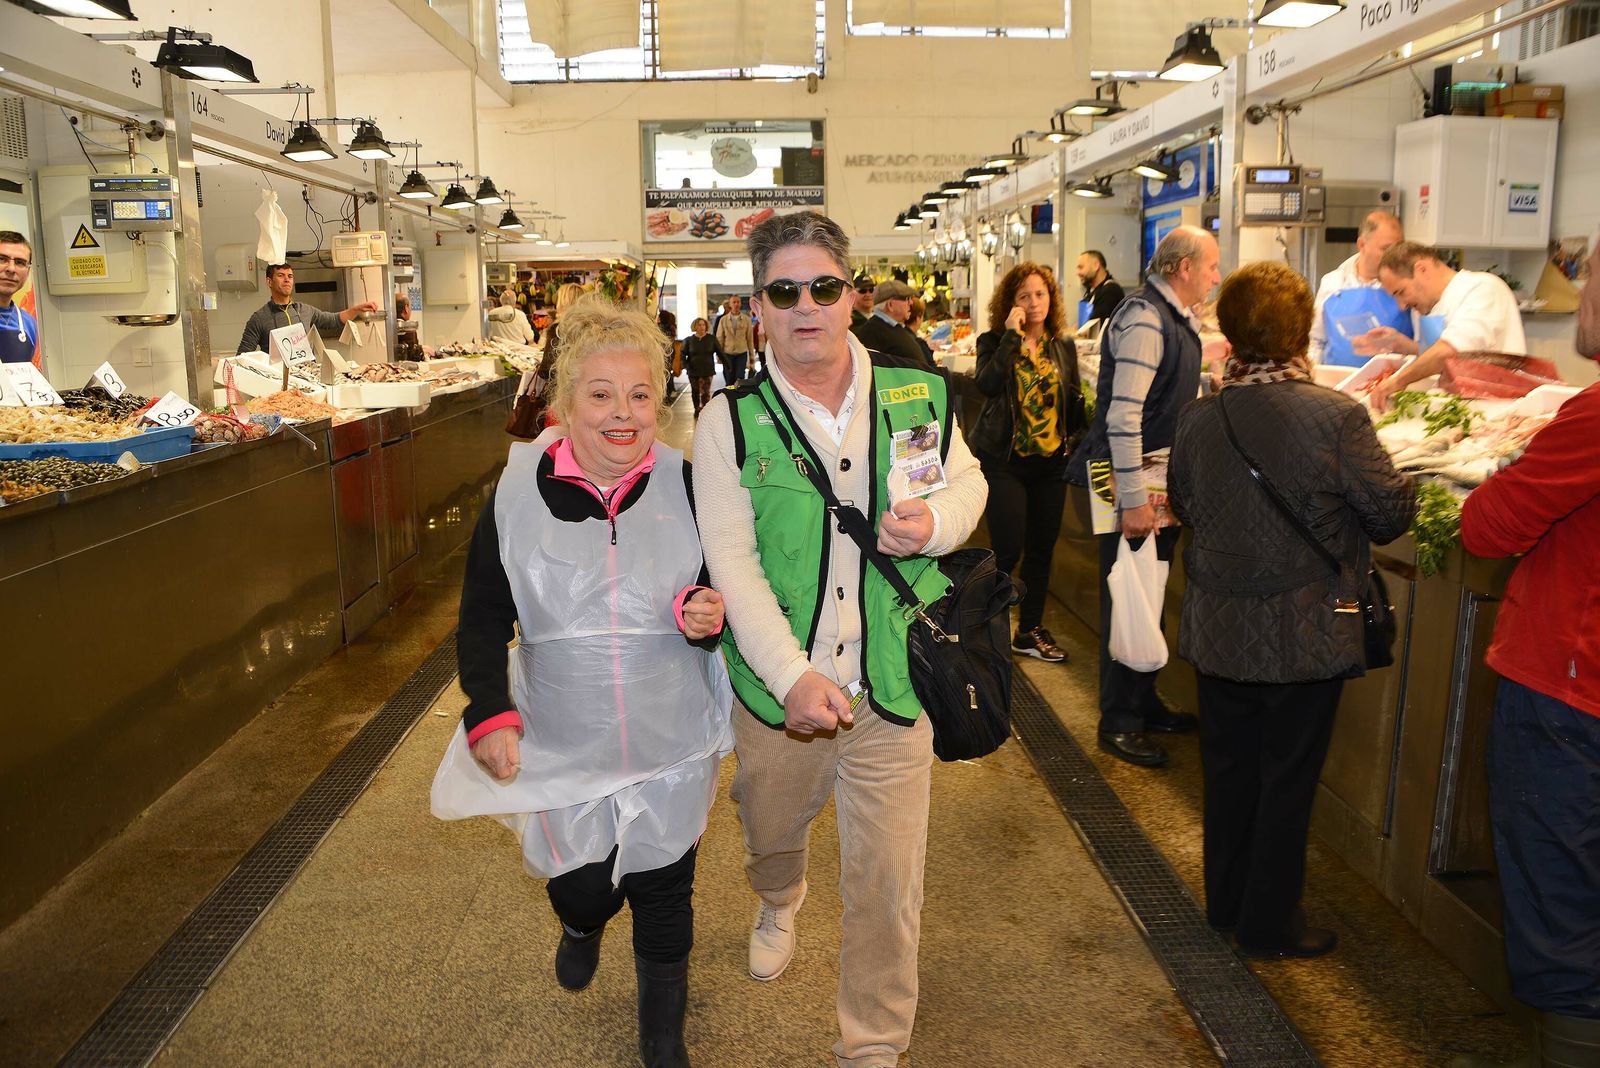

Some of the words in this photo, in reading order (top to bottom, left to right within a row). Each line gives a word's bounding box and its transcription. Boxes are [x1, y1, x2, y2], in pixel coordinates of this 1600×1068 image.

[1360, 3, 1392, 30] Paco
[1258, 48, 1276, 77] 158
[191, 91, 208, 117] 164
[265, 121, 286, 145] David
[1109, 127, 1127, 146] LAURA
[1132, 115, 1150, 136] DAVID
[844, 154, 918, 167] MERCADO
[649, 191, 660, 200] TE
[660, 191, 710, 200] PREPARAMOS
[712, 190, 754, 199] CUALQUIER
[756, 190, 773, 198] TIPO
[775, 190, 785, 198] DE
[786, 190, 821, 198] MARISCO
[677, 202, 693, 210] QUE
[694, 201, 731, 210] COMPRES
[732, 201, 743, 209] EN
[745, 201, 755, 209] EL
[756, 200, 793, 209] MERCADO
[1514, 194, 1537, 206] VISA
[103, 373, 122, 393] 3
[893, 386, 925, 400] ONCE
